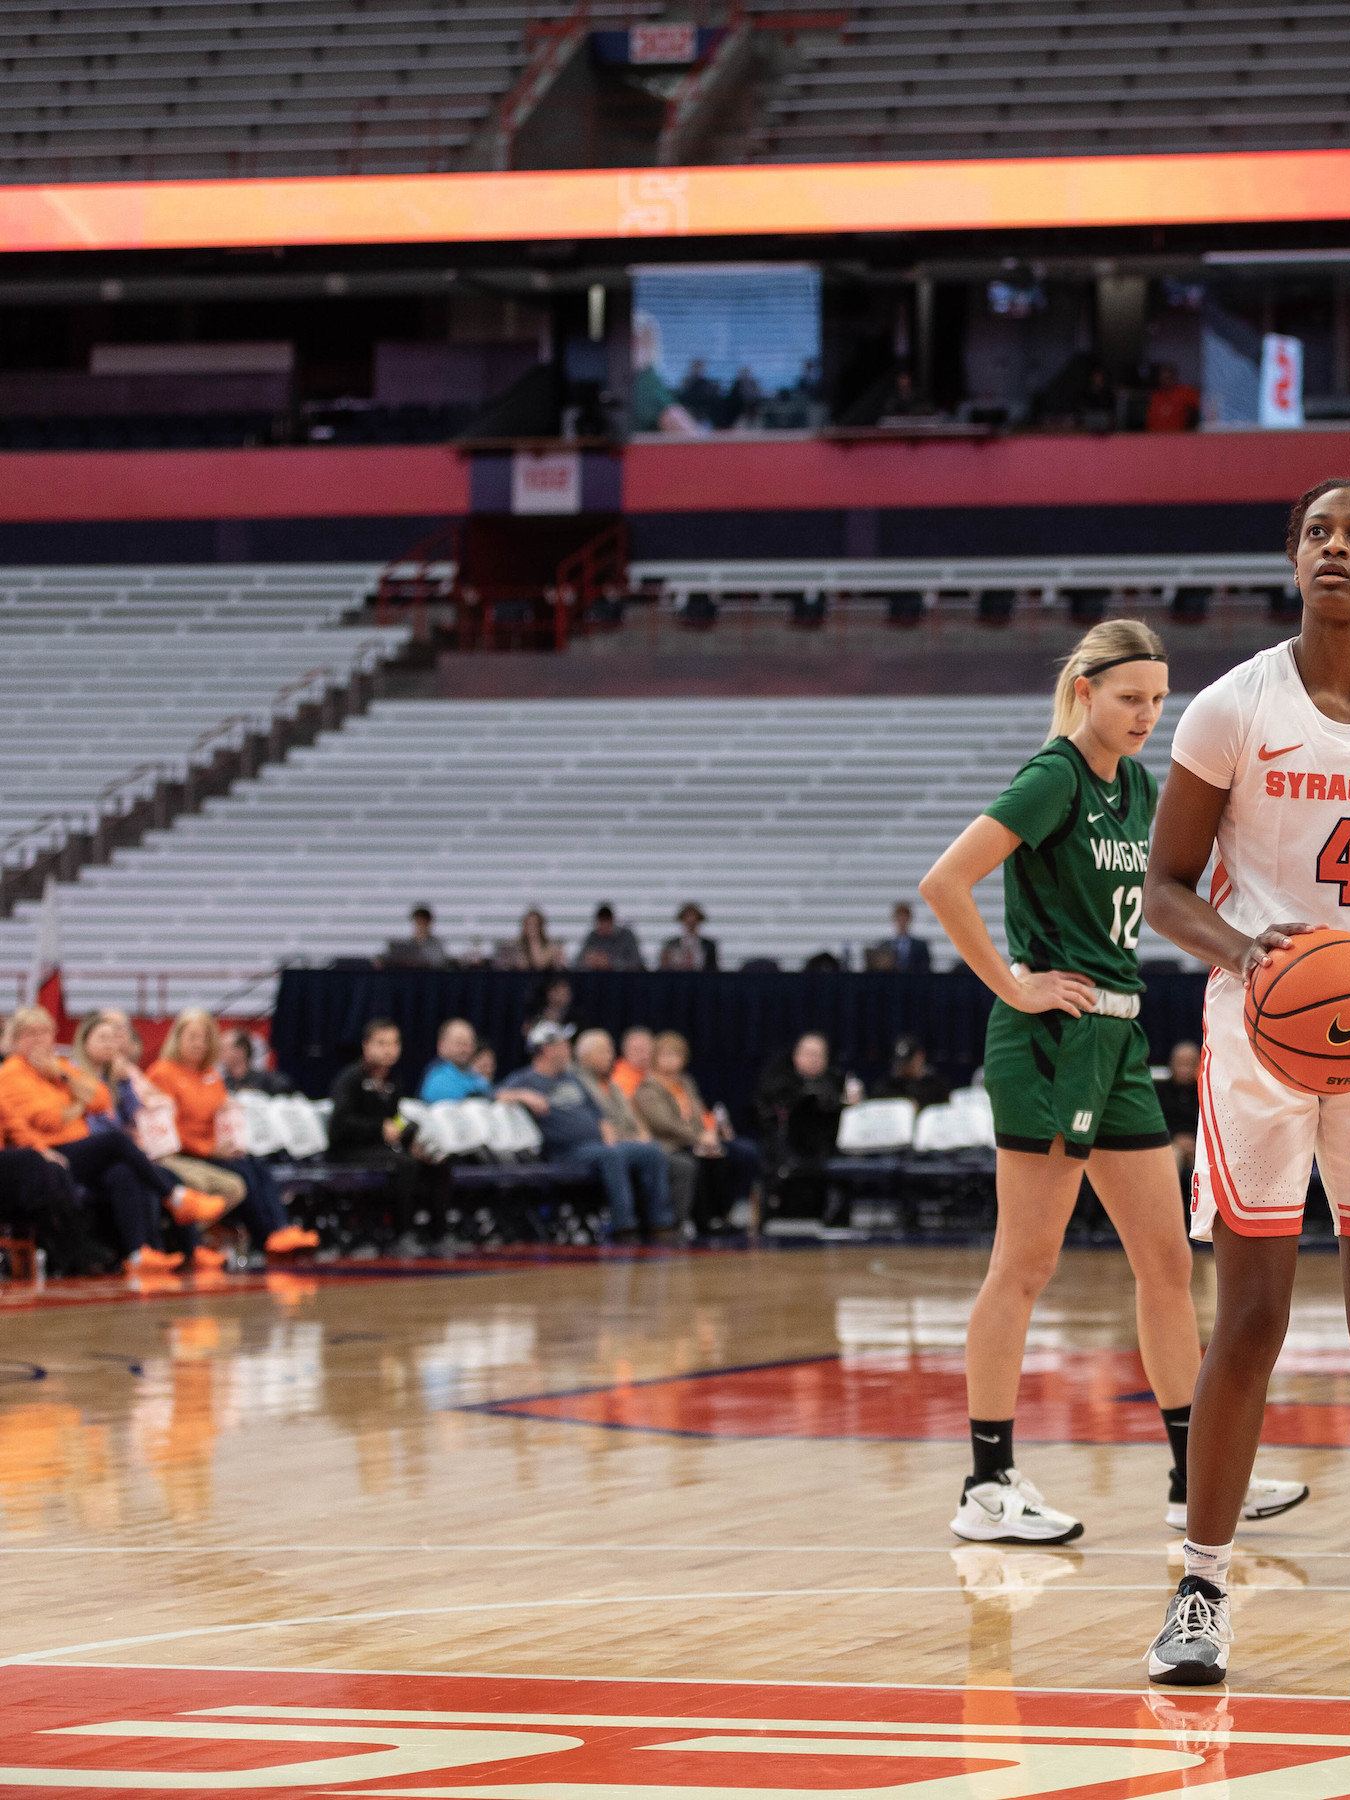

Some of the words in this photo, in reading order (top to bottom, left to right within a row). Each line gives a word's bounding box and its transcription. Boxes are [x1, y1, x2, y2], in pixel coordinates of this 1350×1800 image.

[1089, 837, 1148, 872] WAGNE
[1109, 885, 1142, 949] 12
[1071, 1110, 1093, 1134] W
